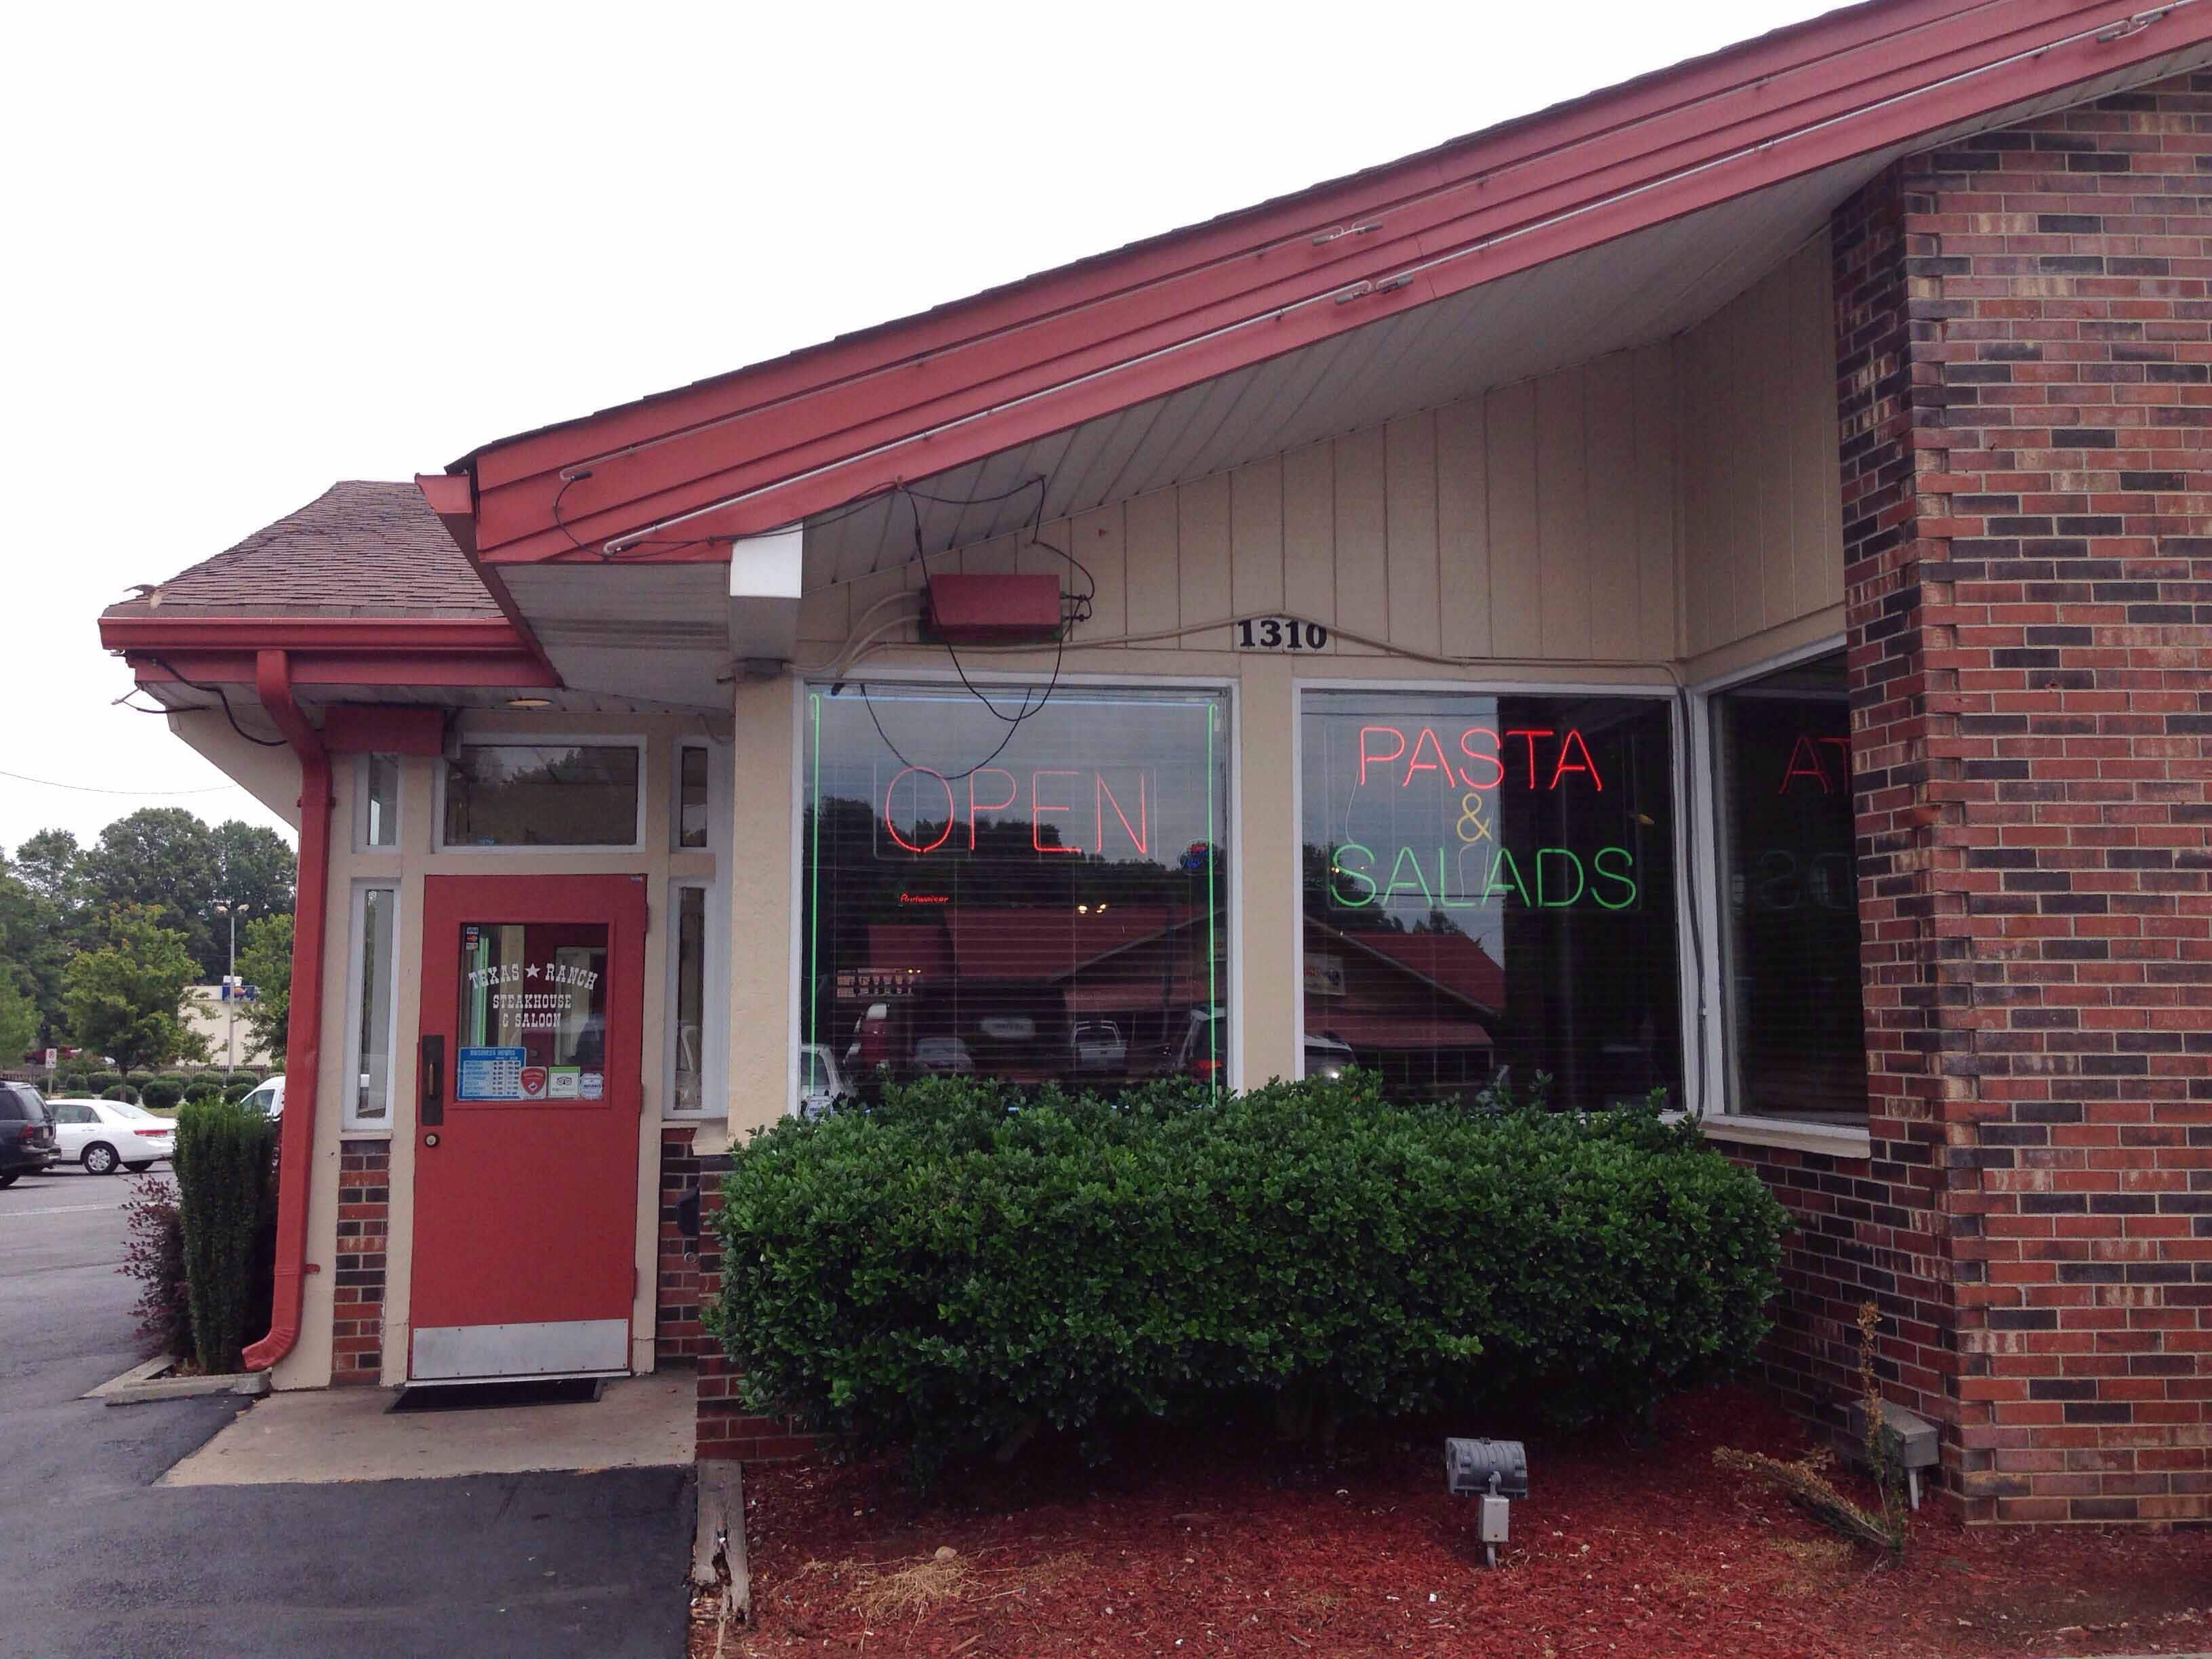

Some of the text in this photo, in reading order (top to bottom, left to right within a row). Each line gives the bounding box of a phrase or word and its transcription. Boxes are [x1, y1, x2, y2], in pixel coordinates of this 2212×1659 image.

[1237, 613, 1328, 649] 1310
[1357, 726, 1603, 792] PASTA
[885, 766, 1147, 854] OPEN
[1456, 792, 1492, 843] &
[1330, 843, 1637, 909] SALADS
[468, 963, 598, 990] TEXAS RANCH
[493, 994, 571, 1009] STEAKHOUSE
[515, 1013, 561, 1027] SALOON
